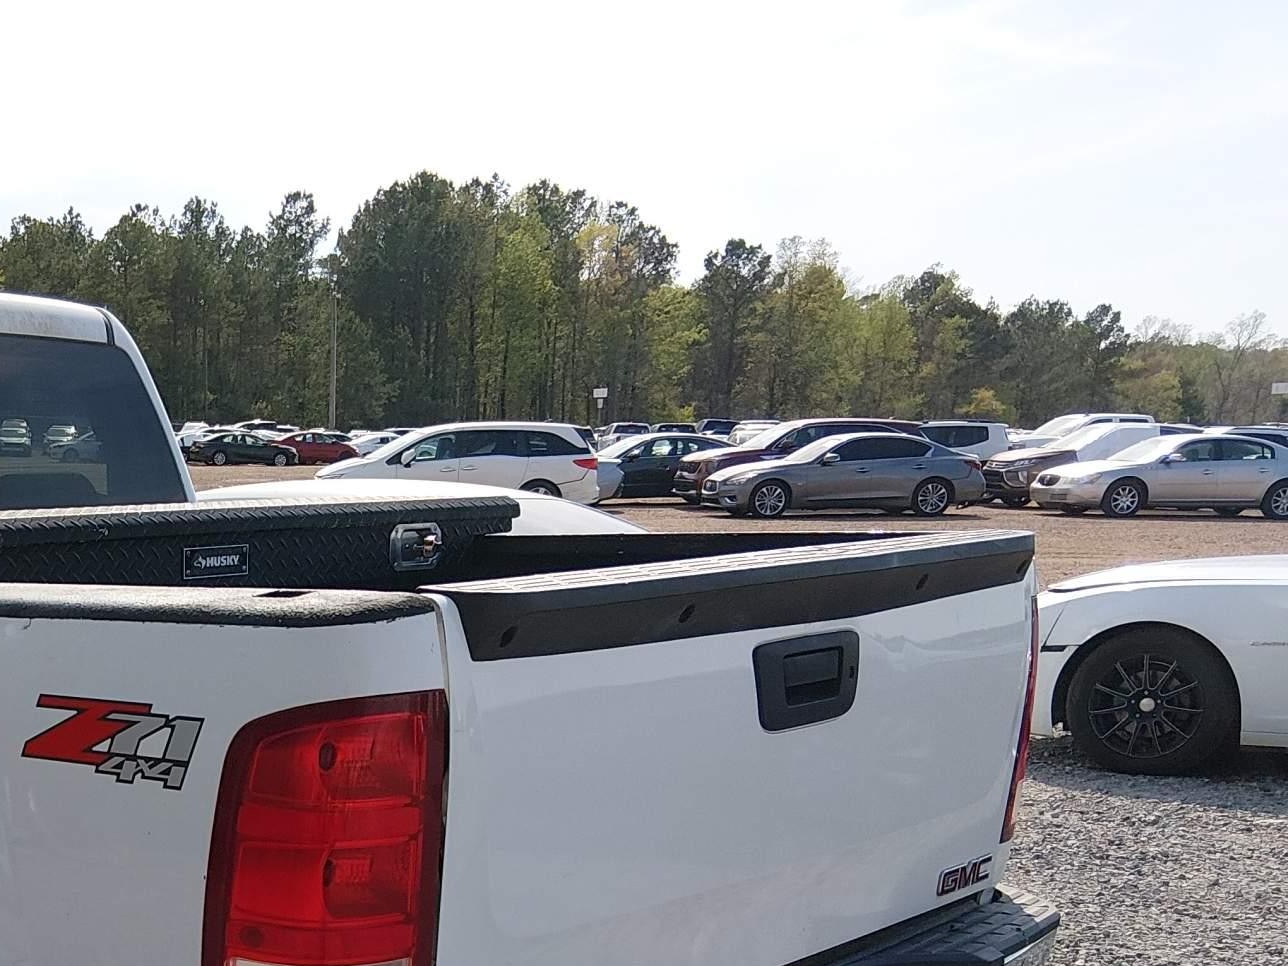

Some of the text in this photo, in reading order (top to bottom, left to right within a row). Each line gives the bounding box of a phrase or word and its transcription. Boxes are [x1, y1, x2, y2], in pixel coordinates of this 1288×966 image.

[206, 554, 240, 568] HUSKY
[21, 693, 205, 766] Z71
[936, 852, 993, 896] GMC
